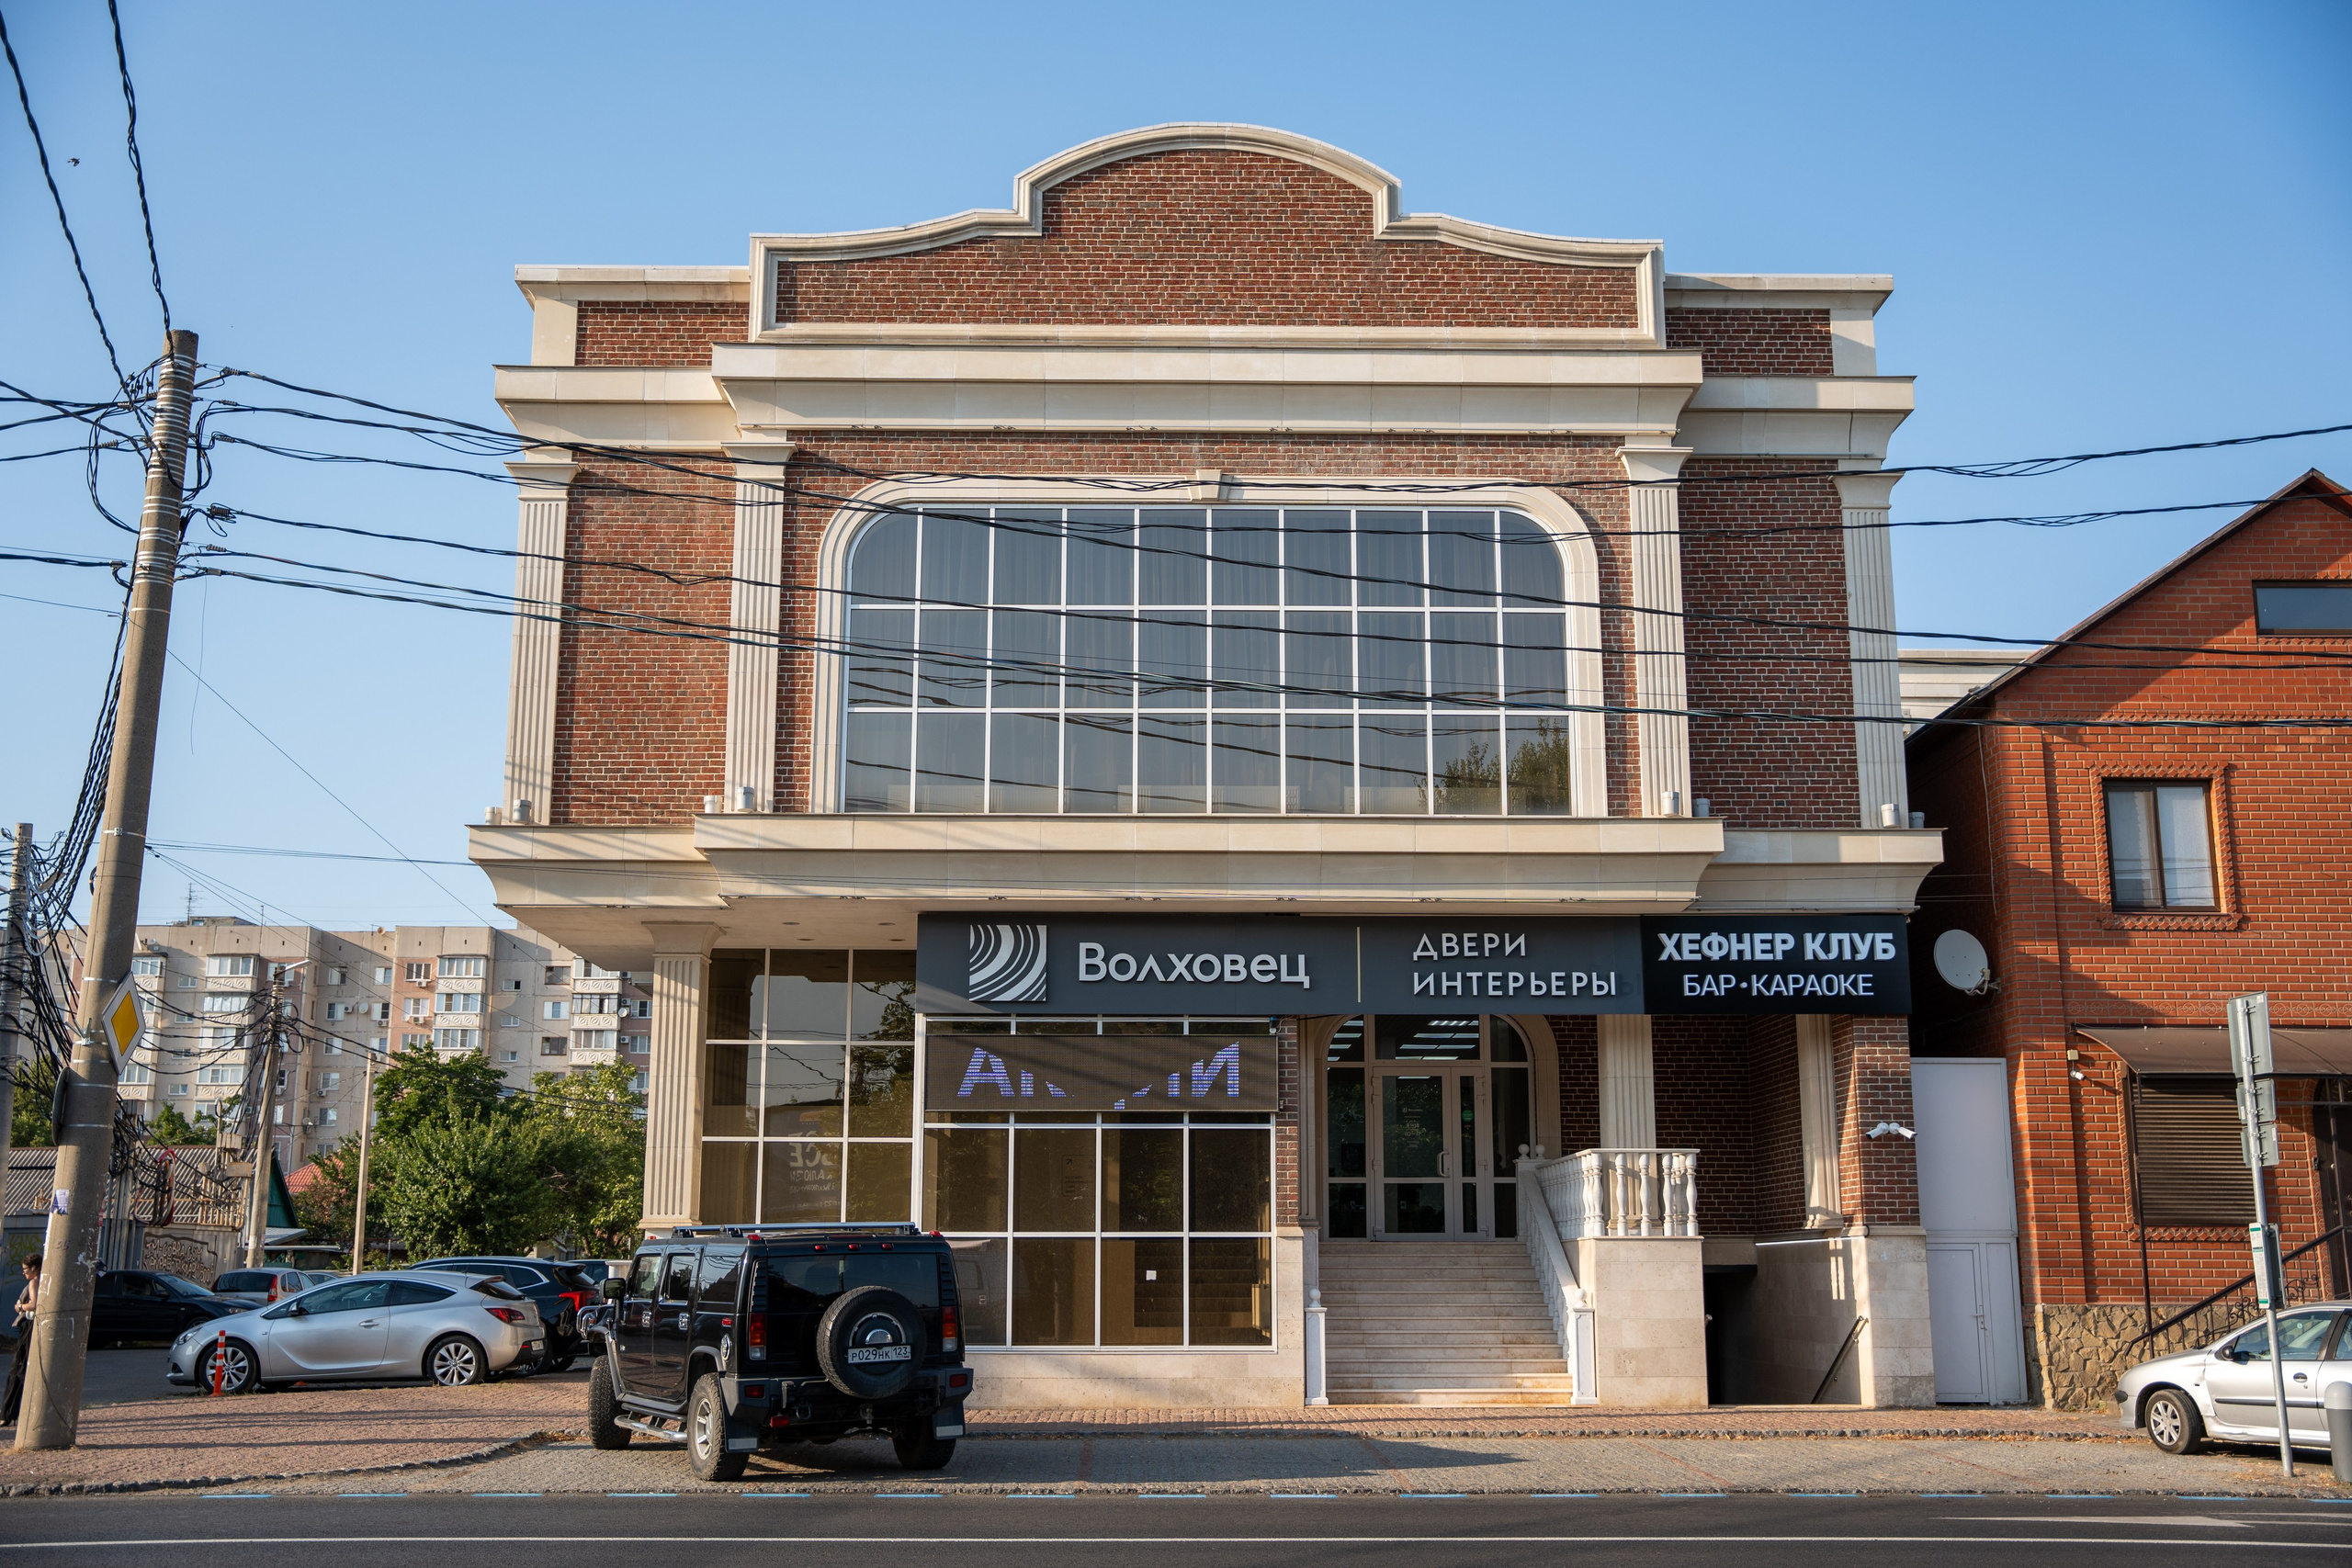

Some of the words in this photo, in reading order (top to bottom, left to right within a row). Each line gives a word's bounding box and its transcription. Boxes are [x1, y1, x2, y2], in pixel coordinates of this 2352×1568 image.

[1412, 932, 1526, 962] ДВЕРИ
[1657, 931, 1795, 961] ХЕФНЕР
[1803, 932, 1897, 961] КЛУБ
[1079, 942, 1310, 989] Волховец
[1413, 971, 1617, 997] ИНТЕРЬЕРЫ
[892, 1347, 908, 1355] 123
